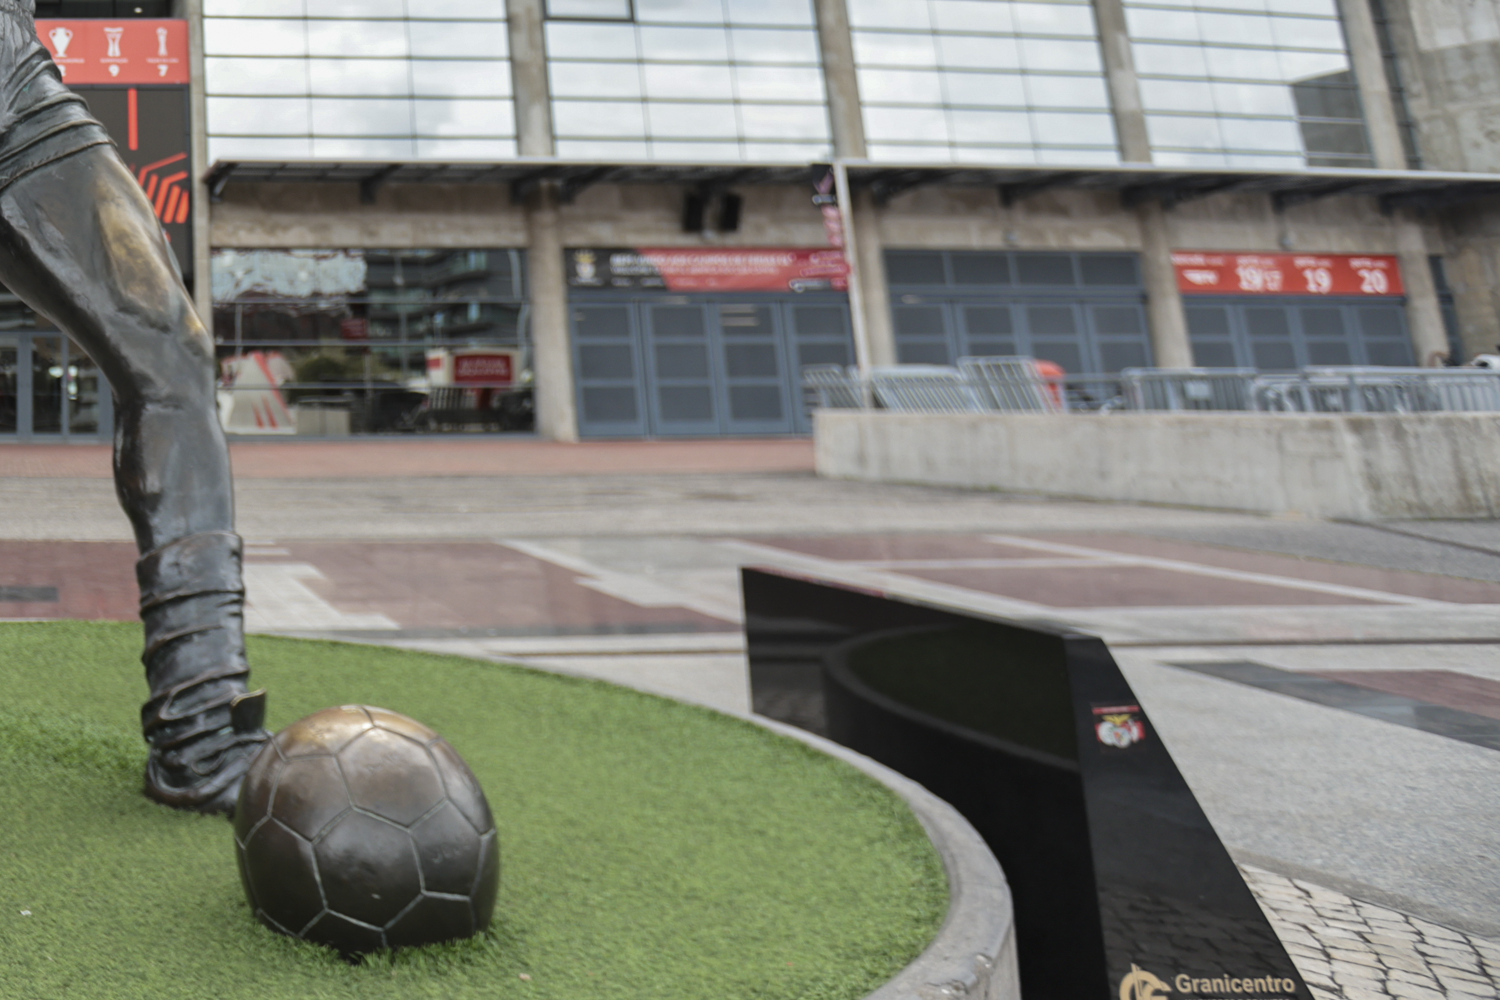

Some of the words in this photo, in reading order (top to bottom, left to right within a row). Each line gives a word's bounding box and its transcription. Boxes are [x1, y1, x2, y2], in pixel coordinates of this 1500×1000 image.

[108, 64, 120, 77] 9
[157, 64, 169, 77] 7
[1303, 268, 1333, 294] 19
[1357, 269, 1388, 294] 20
[1175, 973, 1296, 994] Granicentro
